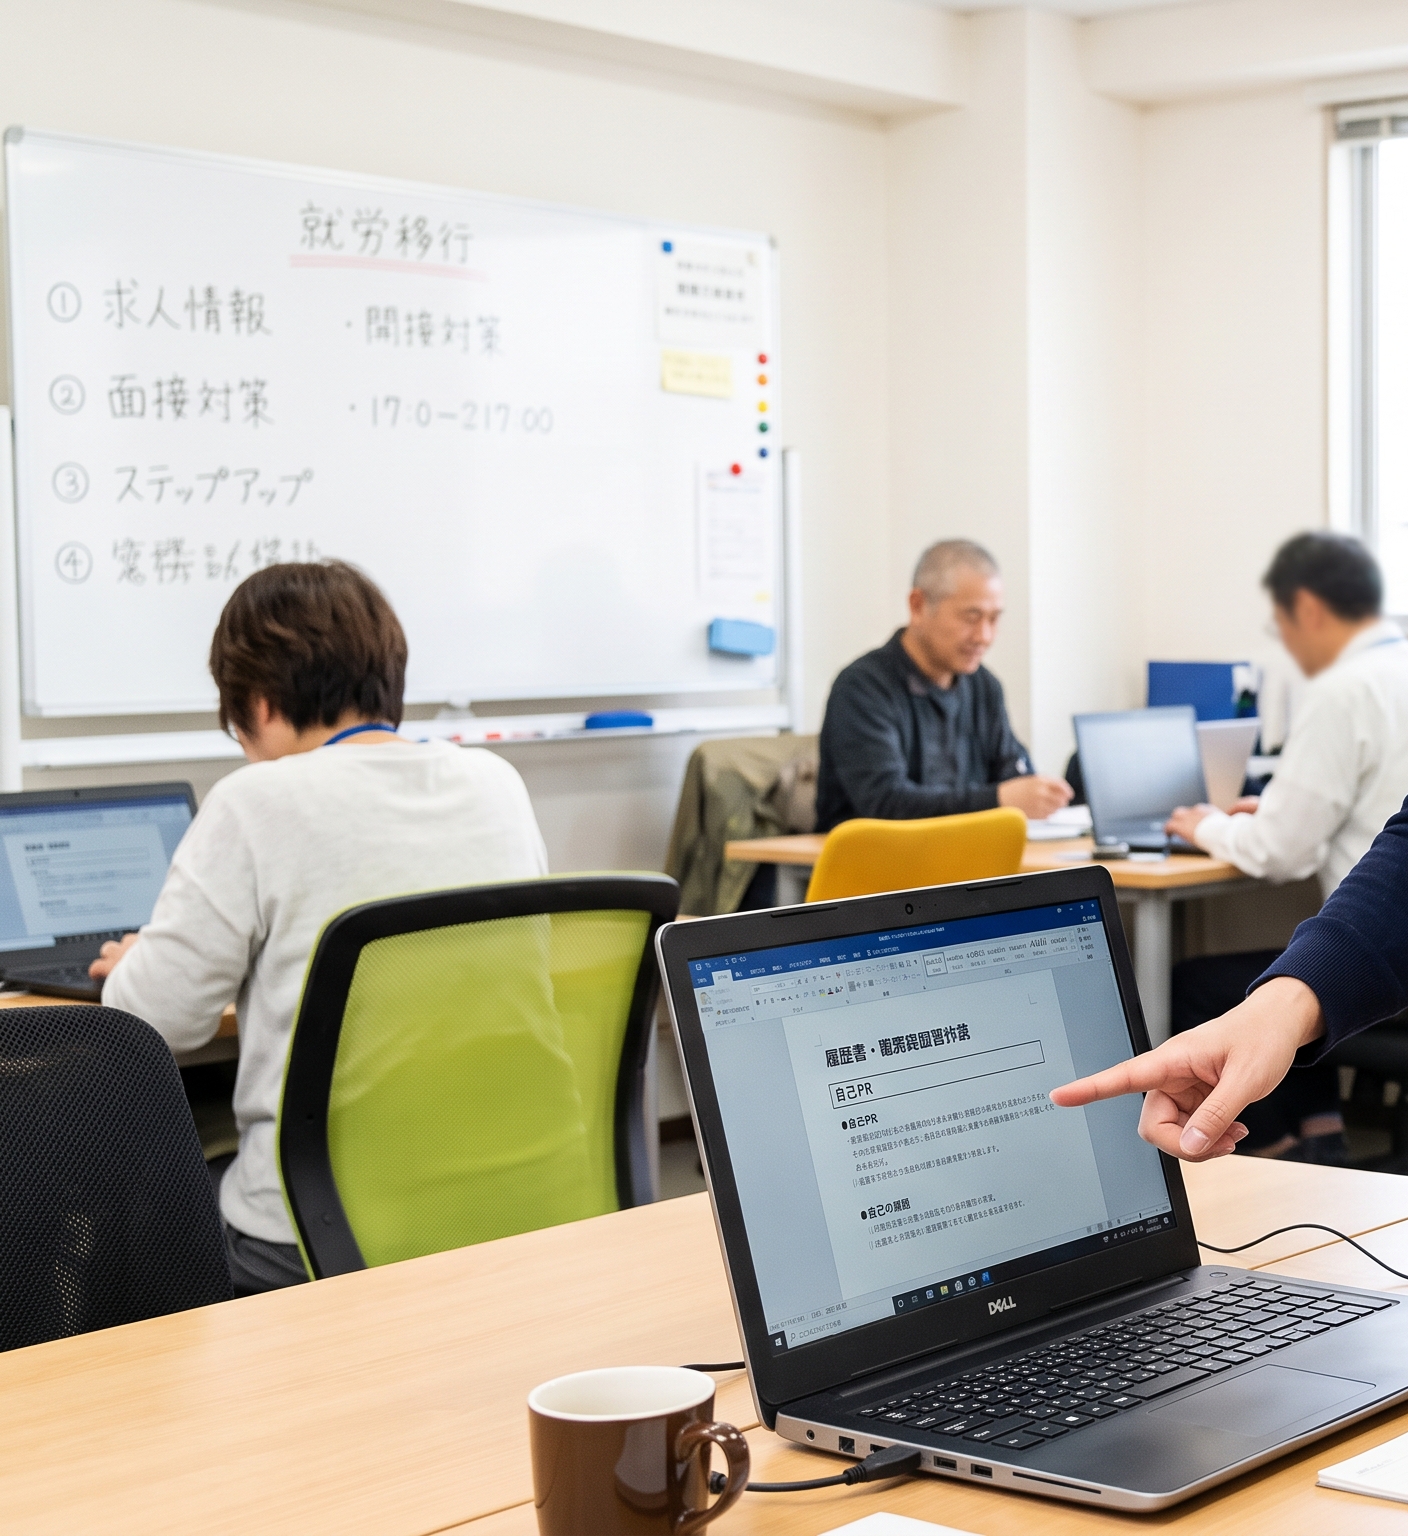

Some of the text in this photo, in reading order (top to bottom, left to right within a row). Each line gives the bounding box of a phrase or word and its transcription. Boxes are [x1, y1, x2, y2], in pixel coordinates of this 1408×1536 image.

[300, 200, 474, 264] 就労移行
[103, 278, 273, 336] 求人情報
[107, 371, 275, 428] 面接対策
[115, 464, 315, 507] ステップアップ
[835, 1082, 874, 1102] 自己PR
